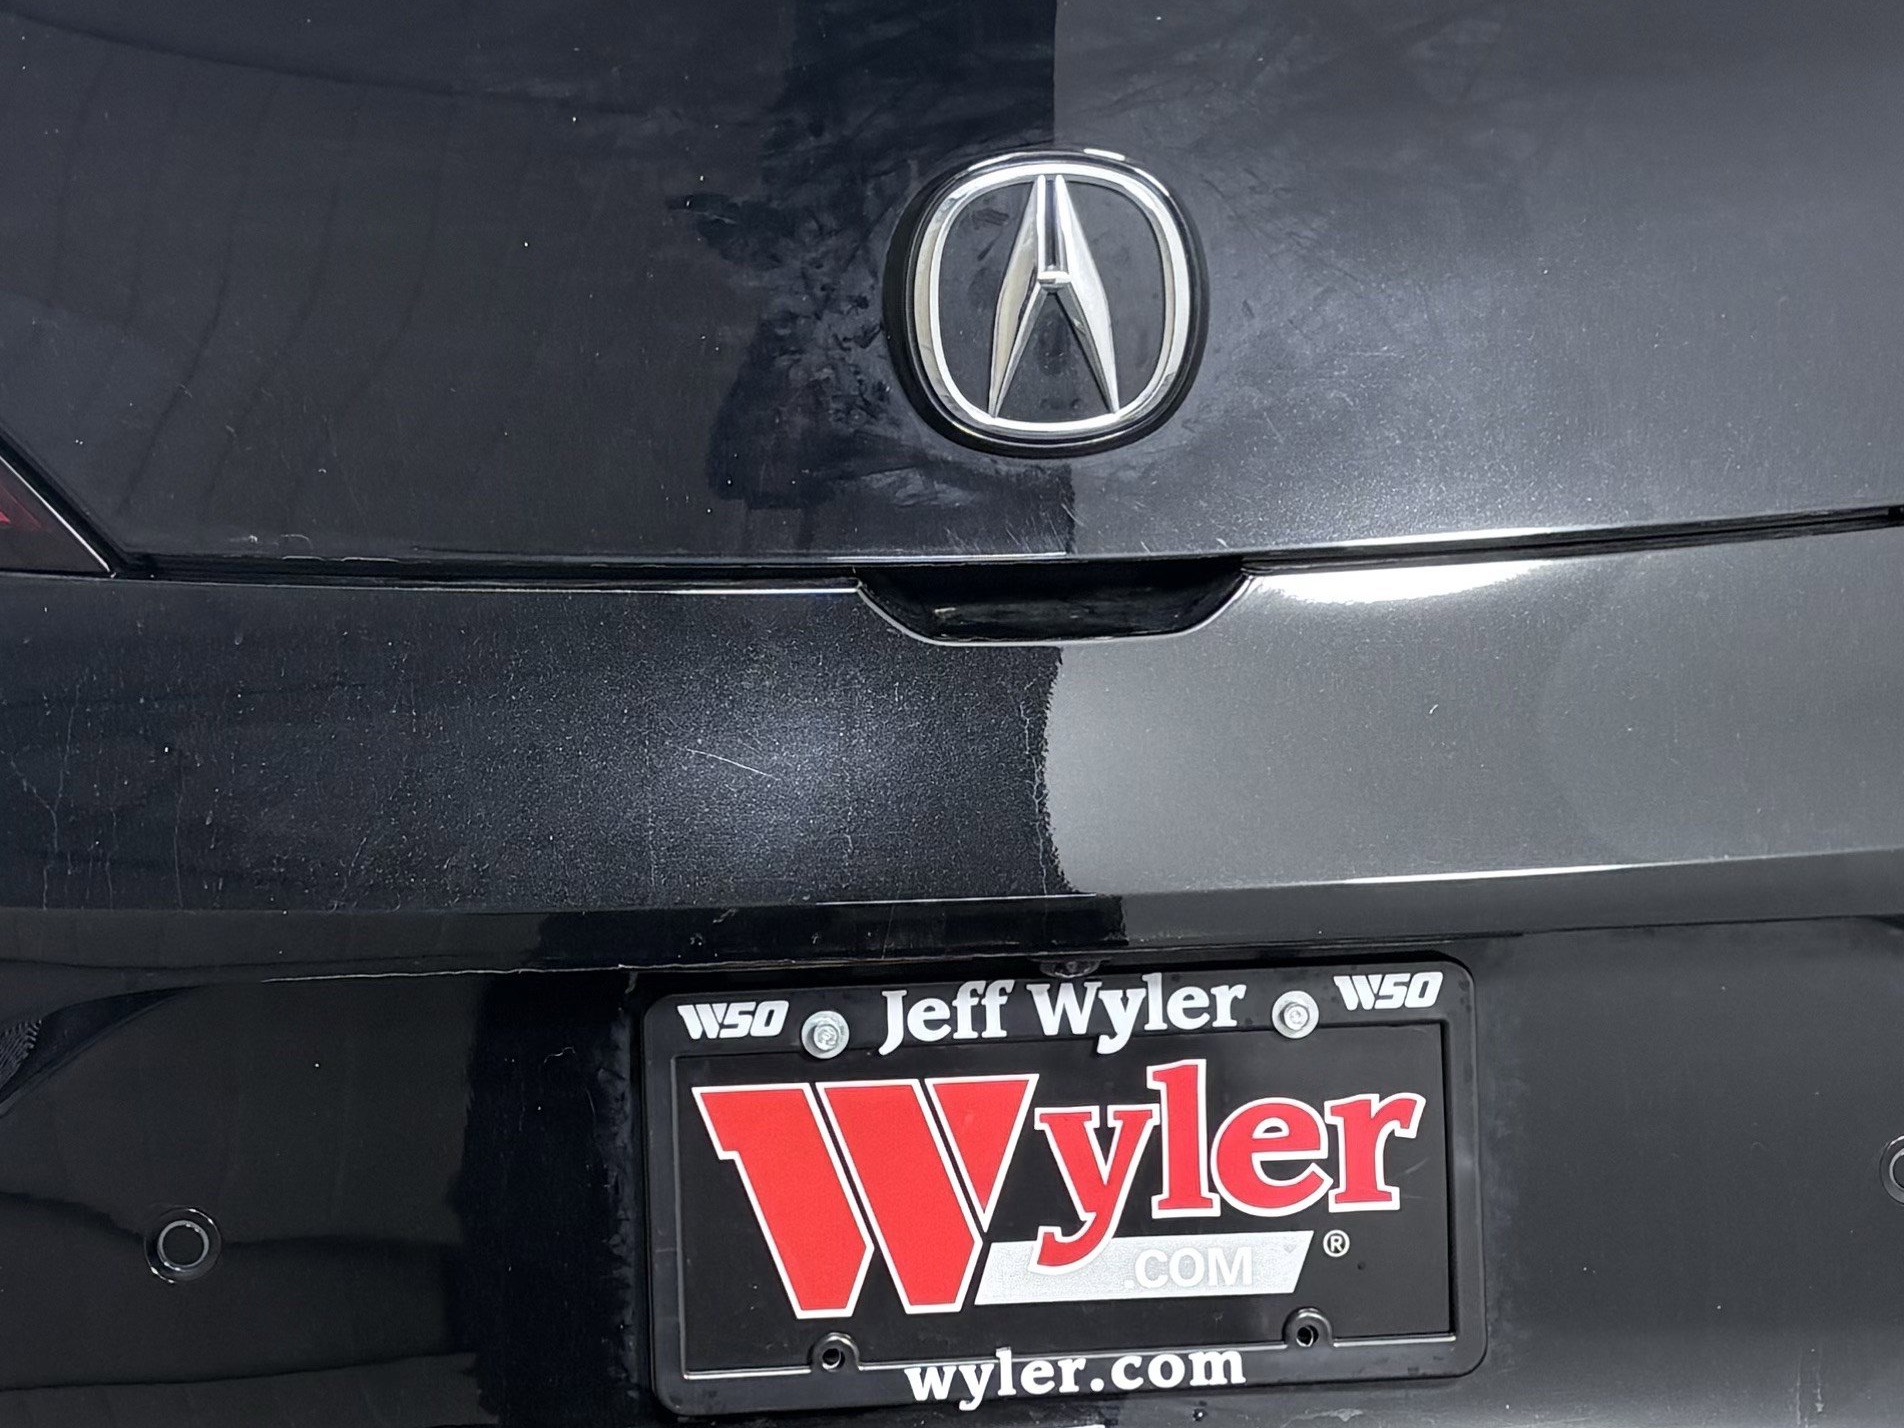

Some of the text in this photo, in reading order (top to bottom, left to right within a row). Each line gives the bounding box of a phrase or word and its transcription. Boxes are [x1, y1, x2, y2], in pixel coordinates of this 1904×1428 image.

[878, 972, 1247, 1056] Jeff Wyler
[692, 1058, 1426, 1320] Wyler
[1124, 1246, 1253, 1290] .COM
[903, 1346, 1247, 1411] wyler.com
